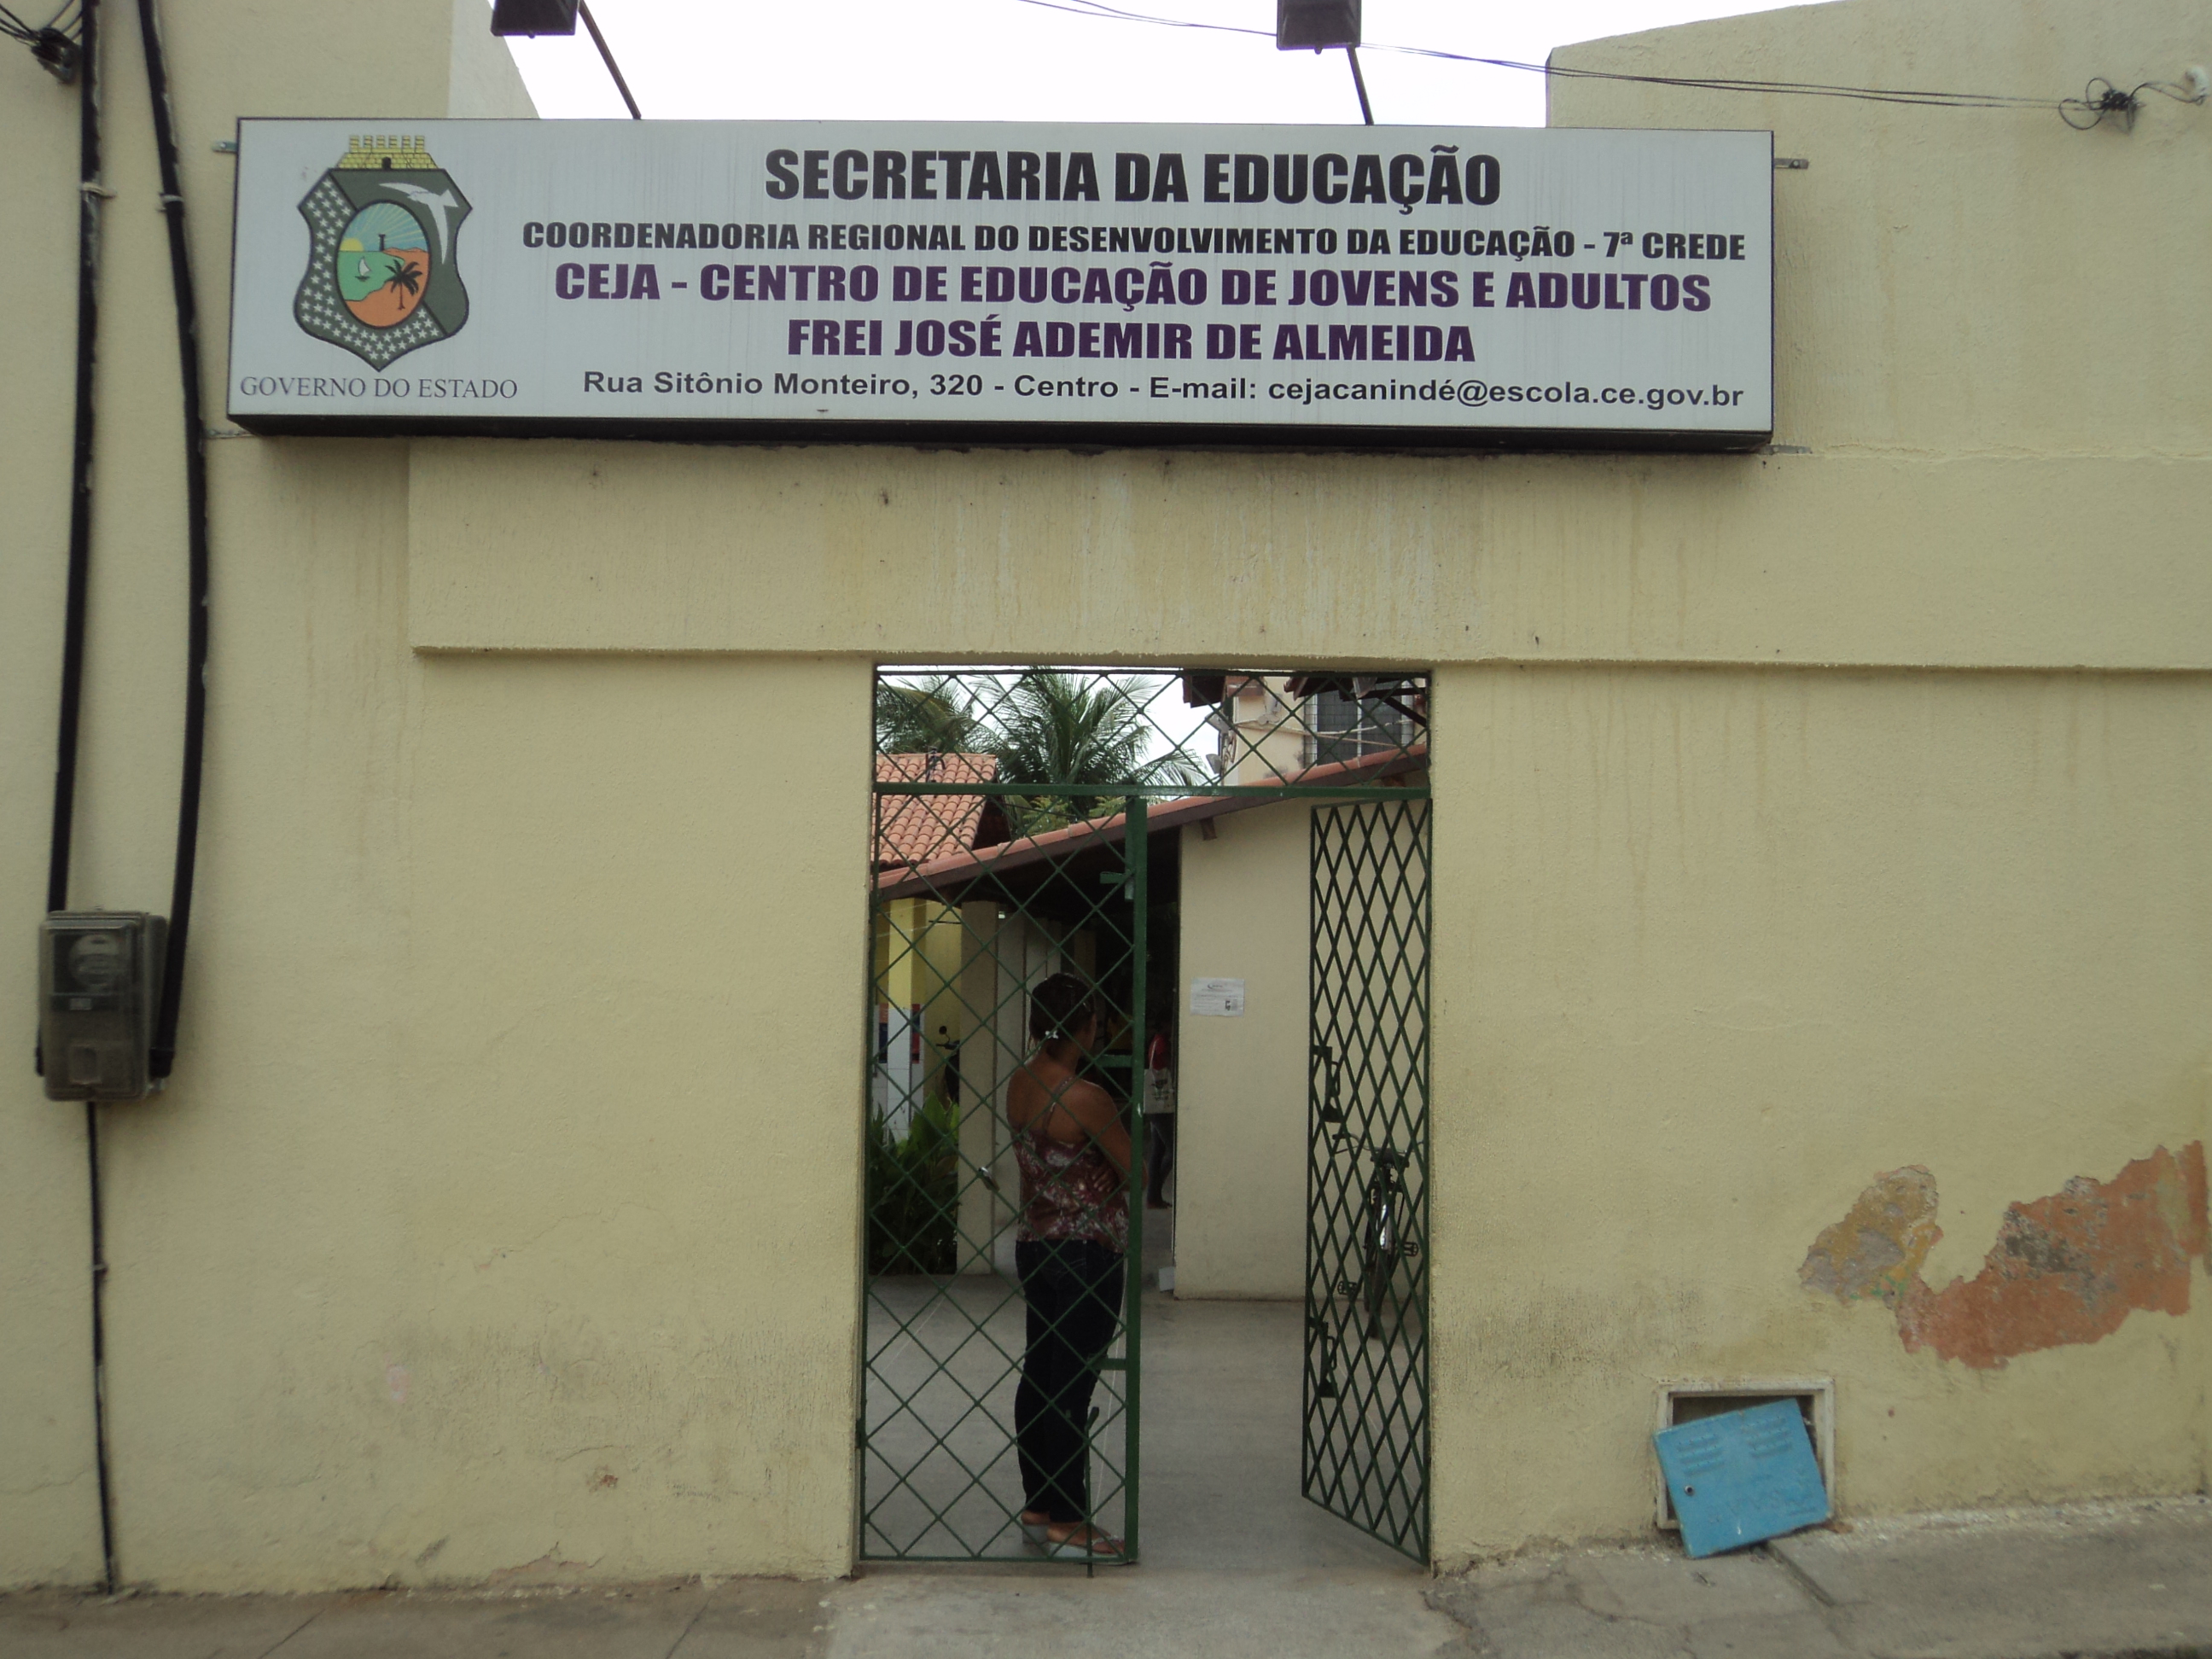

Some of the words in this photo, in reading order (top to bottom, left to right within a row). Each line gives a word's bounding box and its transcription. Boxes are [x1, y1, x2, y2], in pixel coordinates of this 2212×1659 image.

[765, 148, 1100, 201] SECRETARIA
[1115, 152, 1189, 203] DA
[1203, 144, 1500, 216] EDUCAÇÃO
[522, 222, 800, 250] COORDENADORIA
[808, 224, 966, 251] REGIONAL
[975, 224, 1019, 252] DO
[1028, 225, 1337, 255] DESENVOLVIMENTO
[1347, 229, 1391, 255] DA
[1400, 225, 1575, 262] EDUCAÇÃO
[1642, 232, 1745, 260] CREDE
[556, 262, 661, 300] CEJA
[700, 264, 879, 302] CENTRO
[892, 265, 947, 302] DE
[960, 260, 1208, 312] EDUCAÇÃO
[1221, 269, 1277, 306] DE
[1288, 269, 1459, 308] JOVENS
[1472, 271, 1495, 308] E
[1505, 271, 1711, 312] ADULTOS
[788, 319, 882, 356] FREI
[894, 313, 1002, 358] JOSÉ
[1012, 321, 1192, 359] ADEMIR
[1206, 323, 1262, 360] DE
[1272, 323, 1476, 362] ALMEIDA
[240, 376, 366, 398] GOVERNO
[375, 378, 410, 398] DO
[419, 378, 518, 399] ESTADO
[584, 371, 643, 393] Rua
[654, 371, 763, 394] Sitônio
[774, 373, 918, 399] Monteiro,
[930, 374, 983, 396] 320
[1014, 375, 1119, 398] Centro
[1150, 376, 1255, 399] E-mail:
[1268, 378, 1743, 410] cejacanindé@escola.ce.gov.br
